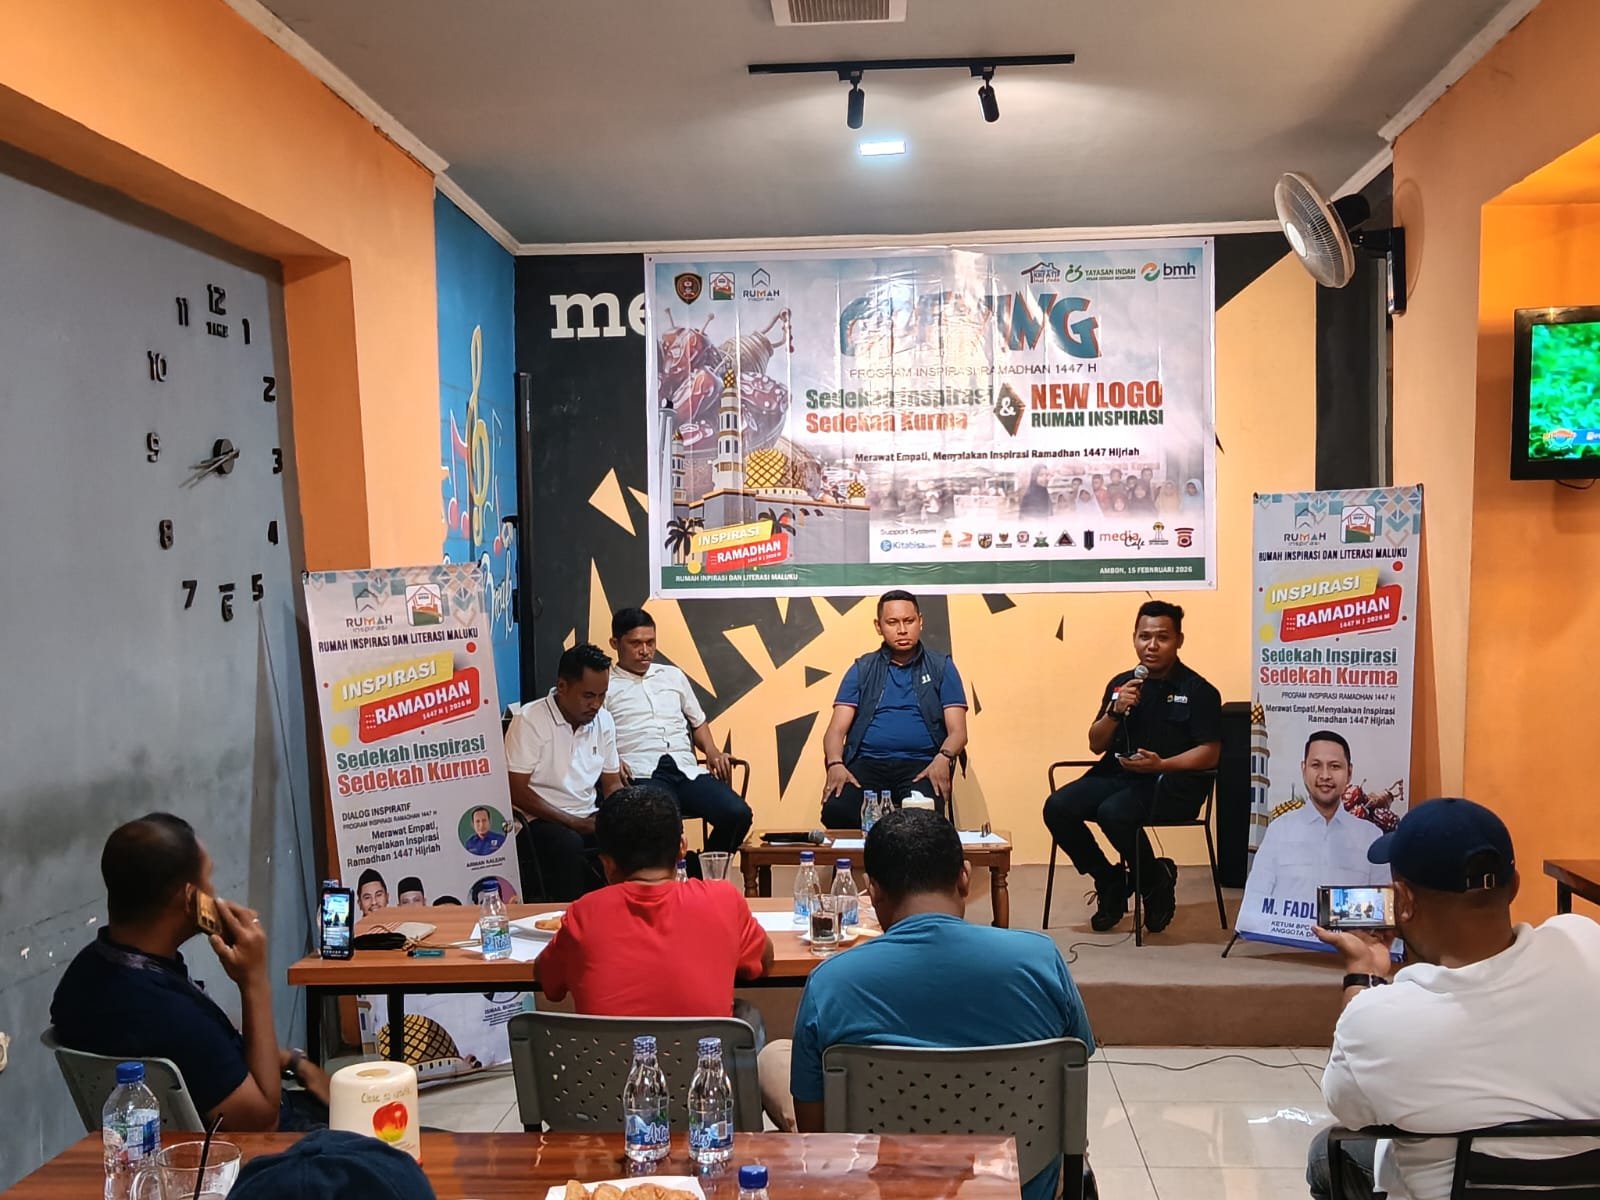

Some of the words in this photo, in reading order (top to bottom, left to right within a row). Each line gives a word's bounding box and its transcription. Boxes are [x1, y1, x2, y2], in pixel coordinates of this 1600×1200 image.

[1163, 263, 1196, 276] bmh
[206, 283, 226, 316] 12
[743, 289, 780, 298] RUMAH
[175, 296, 189, 327] 11
[242, 318, 251, 344] 1
[147, 350, 167, 382] 10
[1055, 363, 1082, 374] 1447
[1087, 362, 1098, 372] H
[262, 376, 276, 402] 2
[1031, 382, 1090, 410] NEW
[1096, 380, 1163, 409] LOGO
[806, 412, 895, 433] Sedekah
[901, 411, 968, 431] Kurma
[1031, 411, 1086, 428] RUMAH
[1088, 409, 1163, 426] INSPIRASI
[146, 432, 161, 462] 9
[855, 452, 894, 463] Merawat
[933, 450, 988, 463] Menyalakan
[990, 450, 1029, 462] Inspirasi
[1032, 448, 1081, 459] Ramadhan
[1083, 448, 1106, 458] 1447
[1109, 446, 1140, 459] Hijriah
[271, 448, 283, 475] 3
[159, 519, 174, 550] 8
[698, 526, 760, 546] INSPIRASI
[1099, 530, 1140, 543] media
[1284, 531, 1327, 542] RUMAH
[716, 540, 781, 564] RAMADHAN
[1258, 552, 1283, 562] RUMAH
[1284, 550, 1321, 562] INSPIRASI
[1322, 549, 1339, 560] DAN
[1340, 548, 1374, 560] LITERASI
[1375, 547, 1408, 559] MALUKU
[182, 579, 198, 610] 7
[251, 573, 264, 602] 5
[1271, 575, 1361, 605] INSPIRASI
[346, 614, 393, 628] RUMAH
[1296, 595, 1390, 628] RAMADHAN
[318, 639, 348, 653] RUMAH
[350, 635, 391, 650] INSPIRASI
[392, 633, 409, 647] DAN
[410, 630, 445, 645] LITERASI
[447, 628, 479, 642] MALUKU
[1261, 647, 1323, 665] Sedekah
[1325, 647, 1397, 667] Inspirasi
[342, 660, 437, 702] INSPIRASI
[1260, 666, 1333, 686] Sedekah
[1336, 666, 1399, 686] Kurma
[374, 679, 471, 725] RAMADHAN
[1281, 690, 1307, 700] PROGRAM
[1308, 691, 1338, 701] INSPIRASI
[1338, 692, 1373, 701] RAMADHAN
[1374, 693, 1389, 702] 1447
[1265, 704, 1292, 713] Merawat
[1363, 706, 1395, 717] Inspirasi
[1307, 715, 1347, 725] Ramadhan
[1349, 716, 1369, 725] 1447
[1370, 716, 1395, 727] Hijriah
[336, 744, 410, 771] Sedekah
[413, 734, 486, 764] Inspirasi
[337, 764, 425, 796] Sedekah
[428, 757, 490, 782] Kurma
[342, 809, 370, 822] DIALOG
[371, 802, 411, 818] INSPIRATIF
[372, 826, 407, 840] Merawat
[408, 820, 439, 836] Empati,
[356, 838, 405, 855] Menyalakan
[406, 831, 440, 847] Inspirasi
[347, 852, 392, 868] Ramadhan
[393, 847, 413, 860] 1447
[415, 843, 441, 858] Hijriah
[1262, 897, 1278, 915] M.
[1271, 920, 1295, 929] KETUM
[1271, 927, 1304, 937] ANGGOTA
